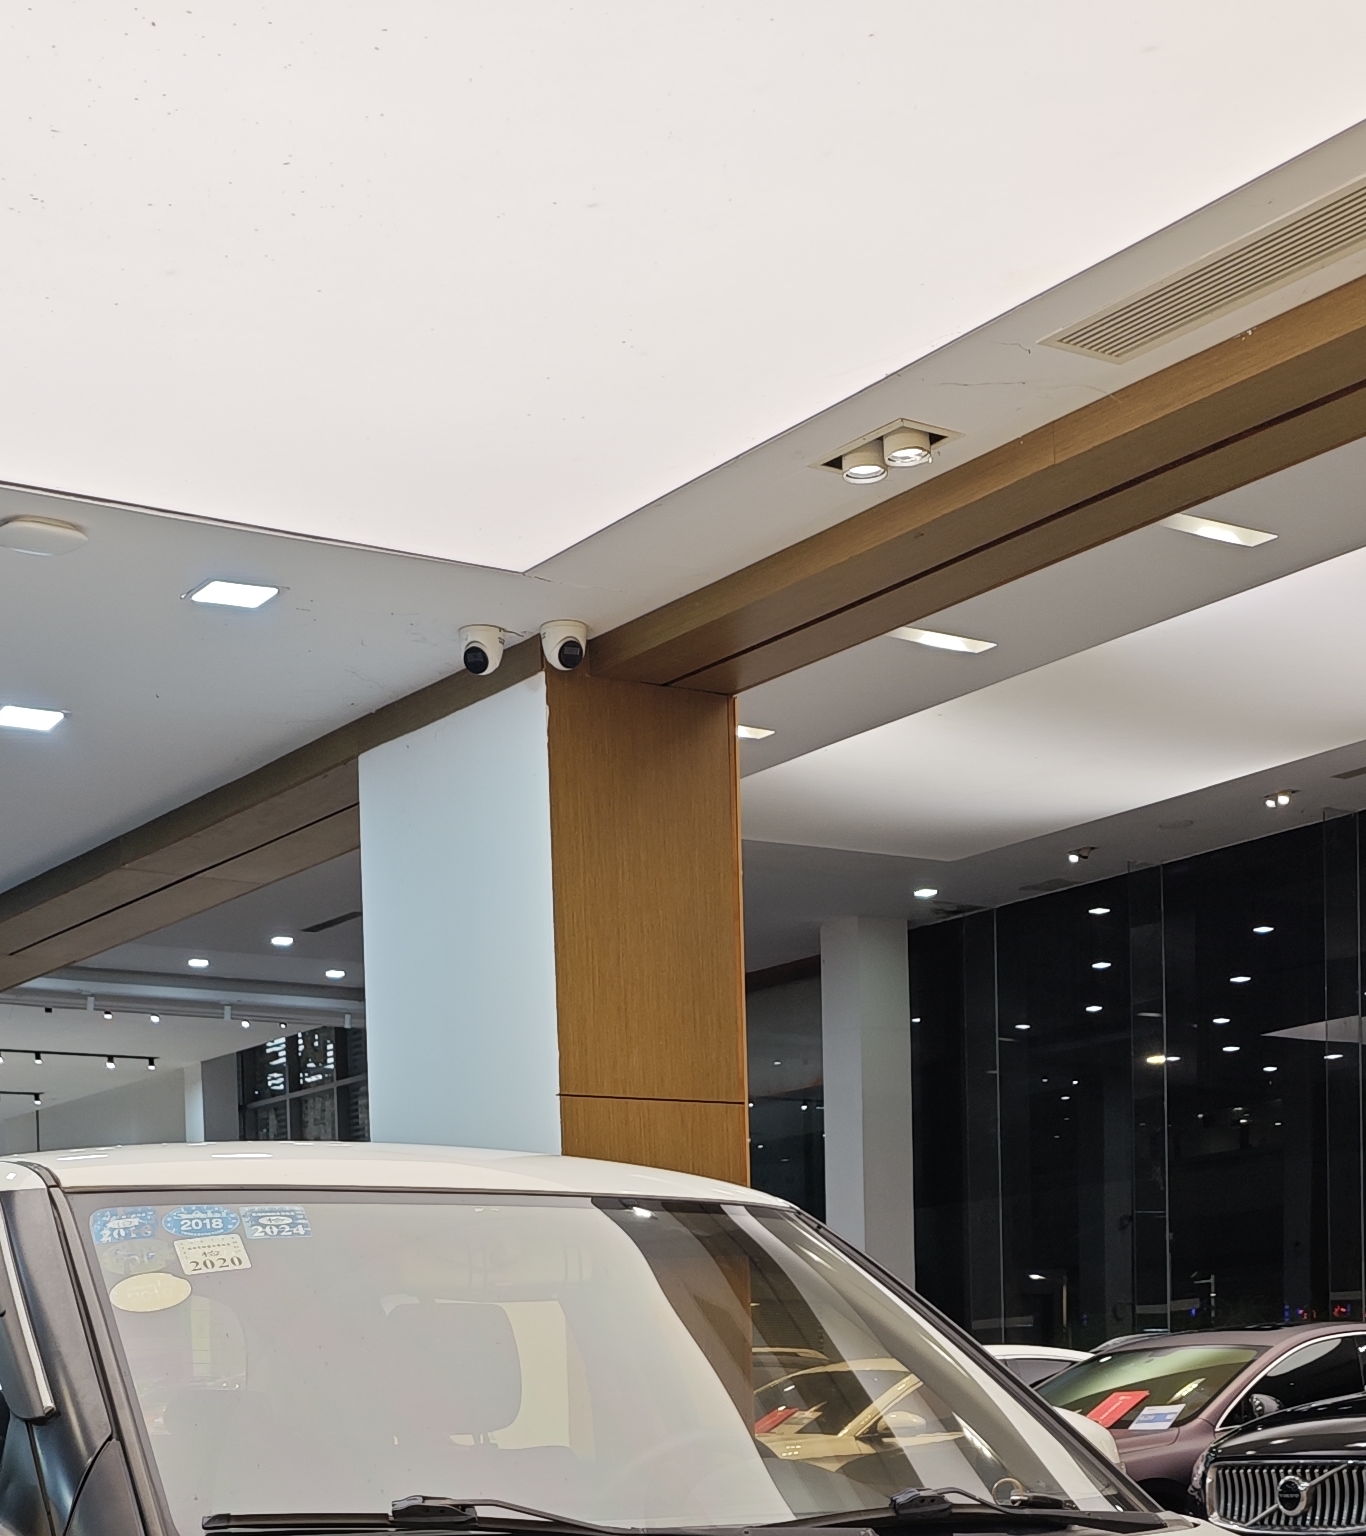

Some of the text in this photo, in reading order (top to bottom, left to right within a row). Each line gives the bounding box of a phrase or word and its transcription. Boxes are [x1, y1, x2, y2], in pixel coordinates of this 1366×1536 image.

[179, 1218, 224, 1231] 2018
[251, 1224, 307, 1238] 2024
[189, 1255, 243, 1272] 2020
